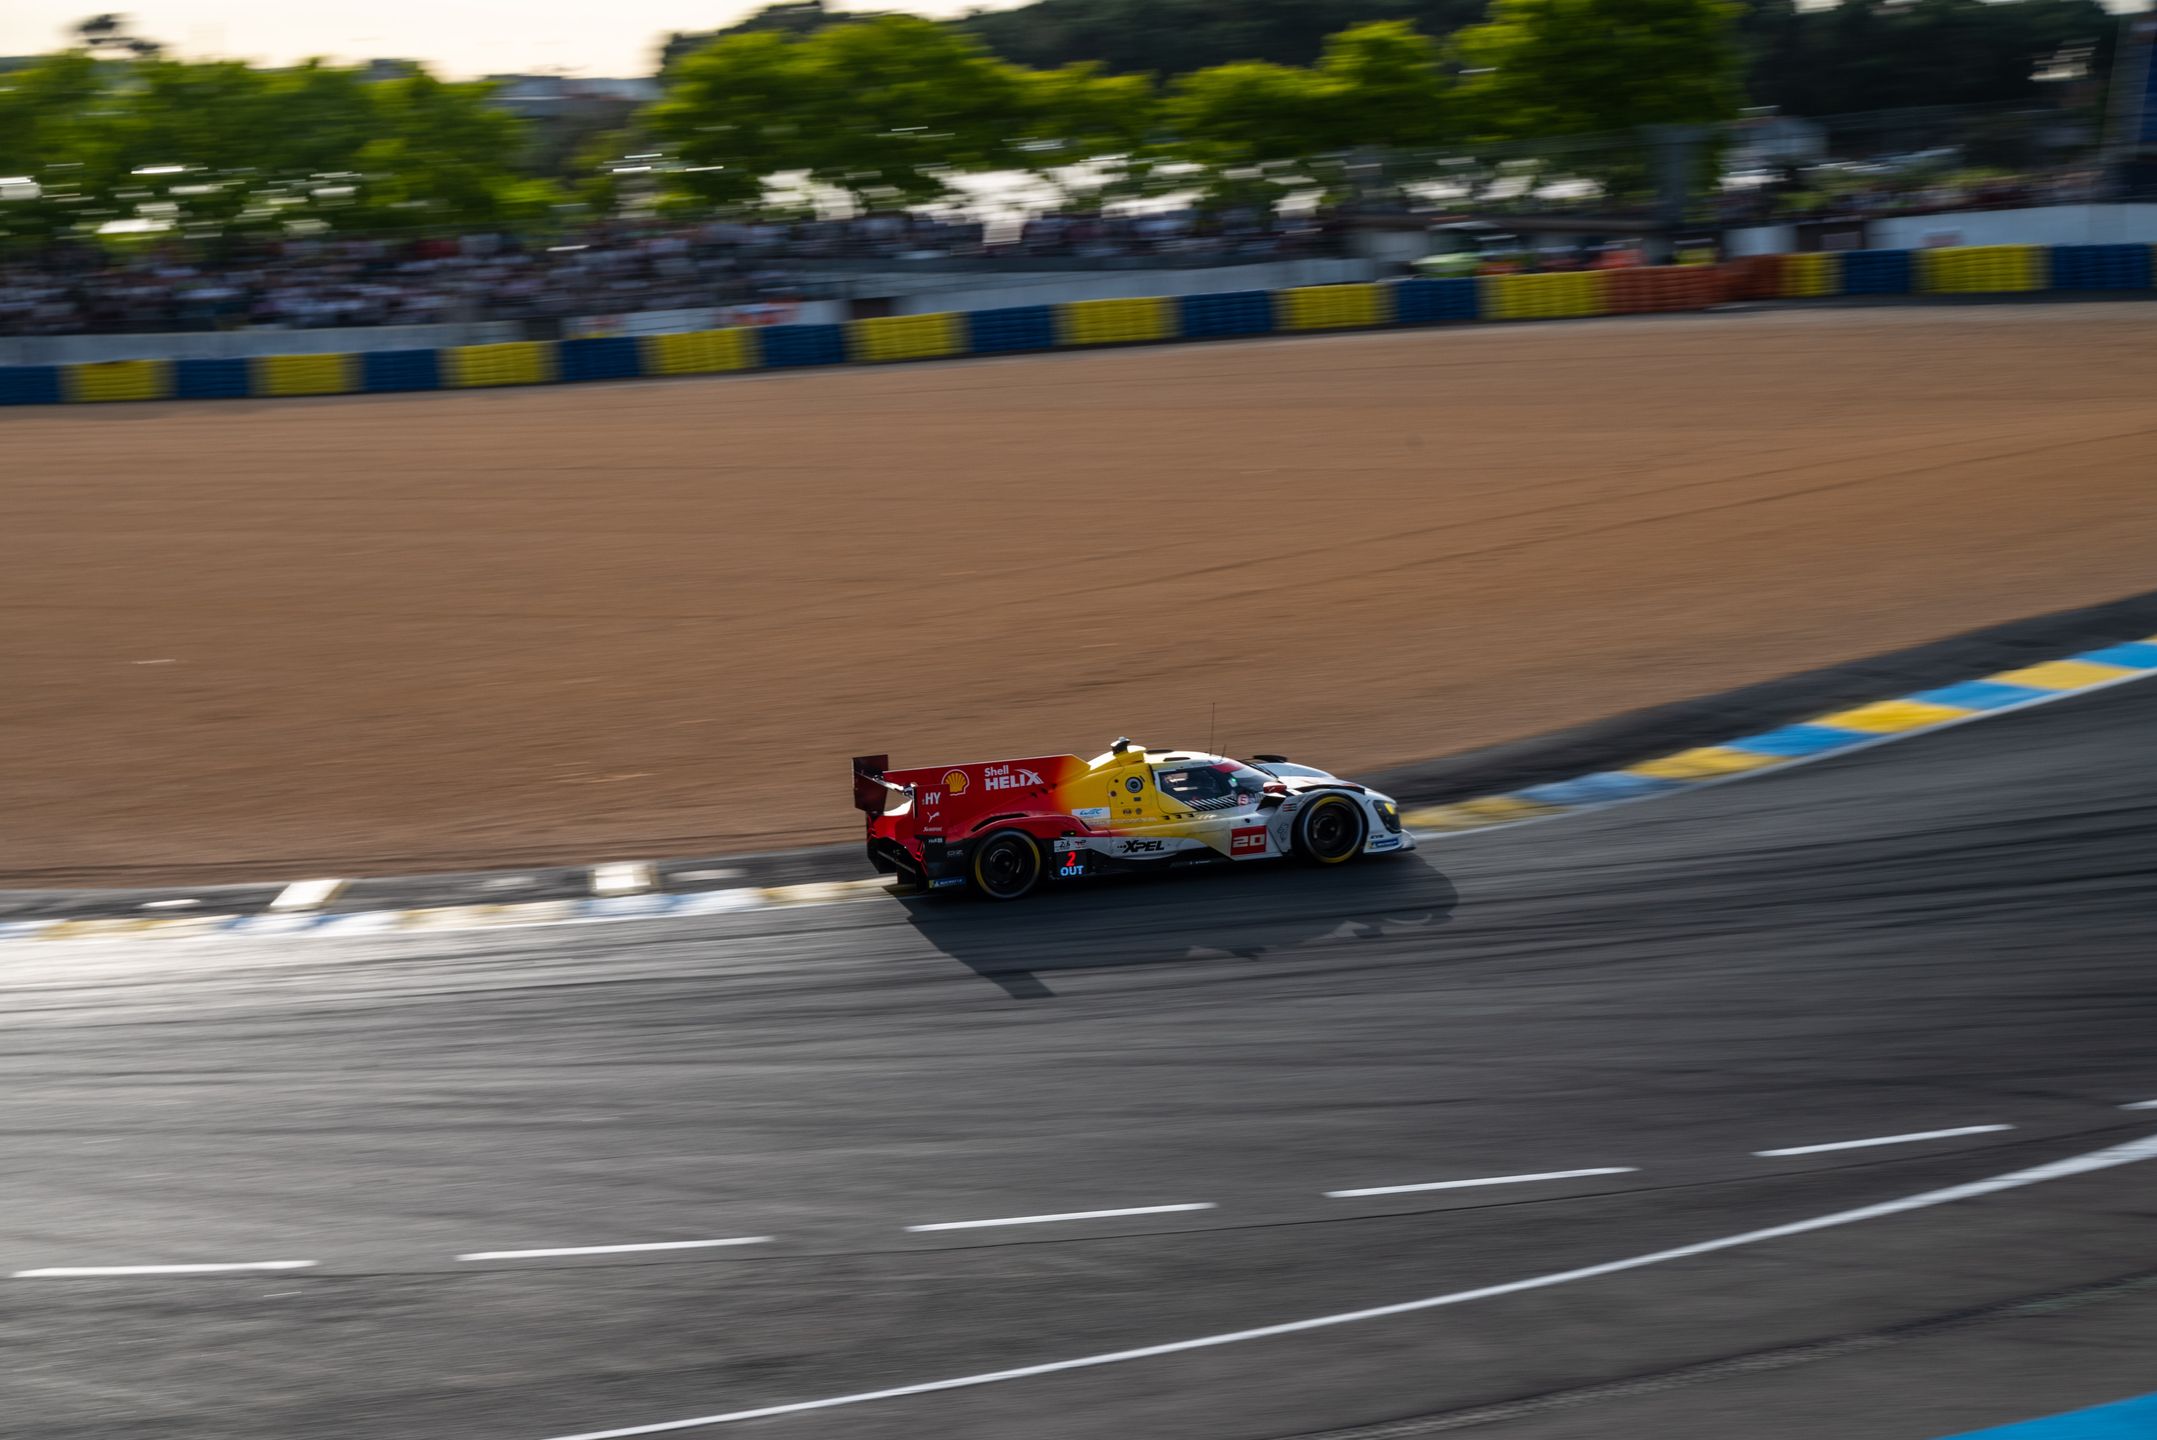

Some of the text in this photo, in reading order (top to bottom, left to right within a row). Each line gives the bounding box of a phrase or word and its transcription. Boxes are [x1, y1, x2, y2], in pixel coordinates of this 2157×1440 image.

[984, 765, 1009, 777] Shell
[984, 769, 1044, 791] HELIX
[925, 792, 941, 805] HY
[1123, 840, 1165, 853] XPEL
[1232, 834, 1265, 848] 20
[1065, 851, 1077, 867] 2
[1060, 865, 1084, 877] OUT
